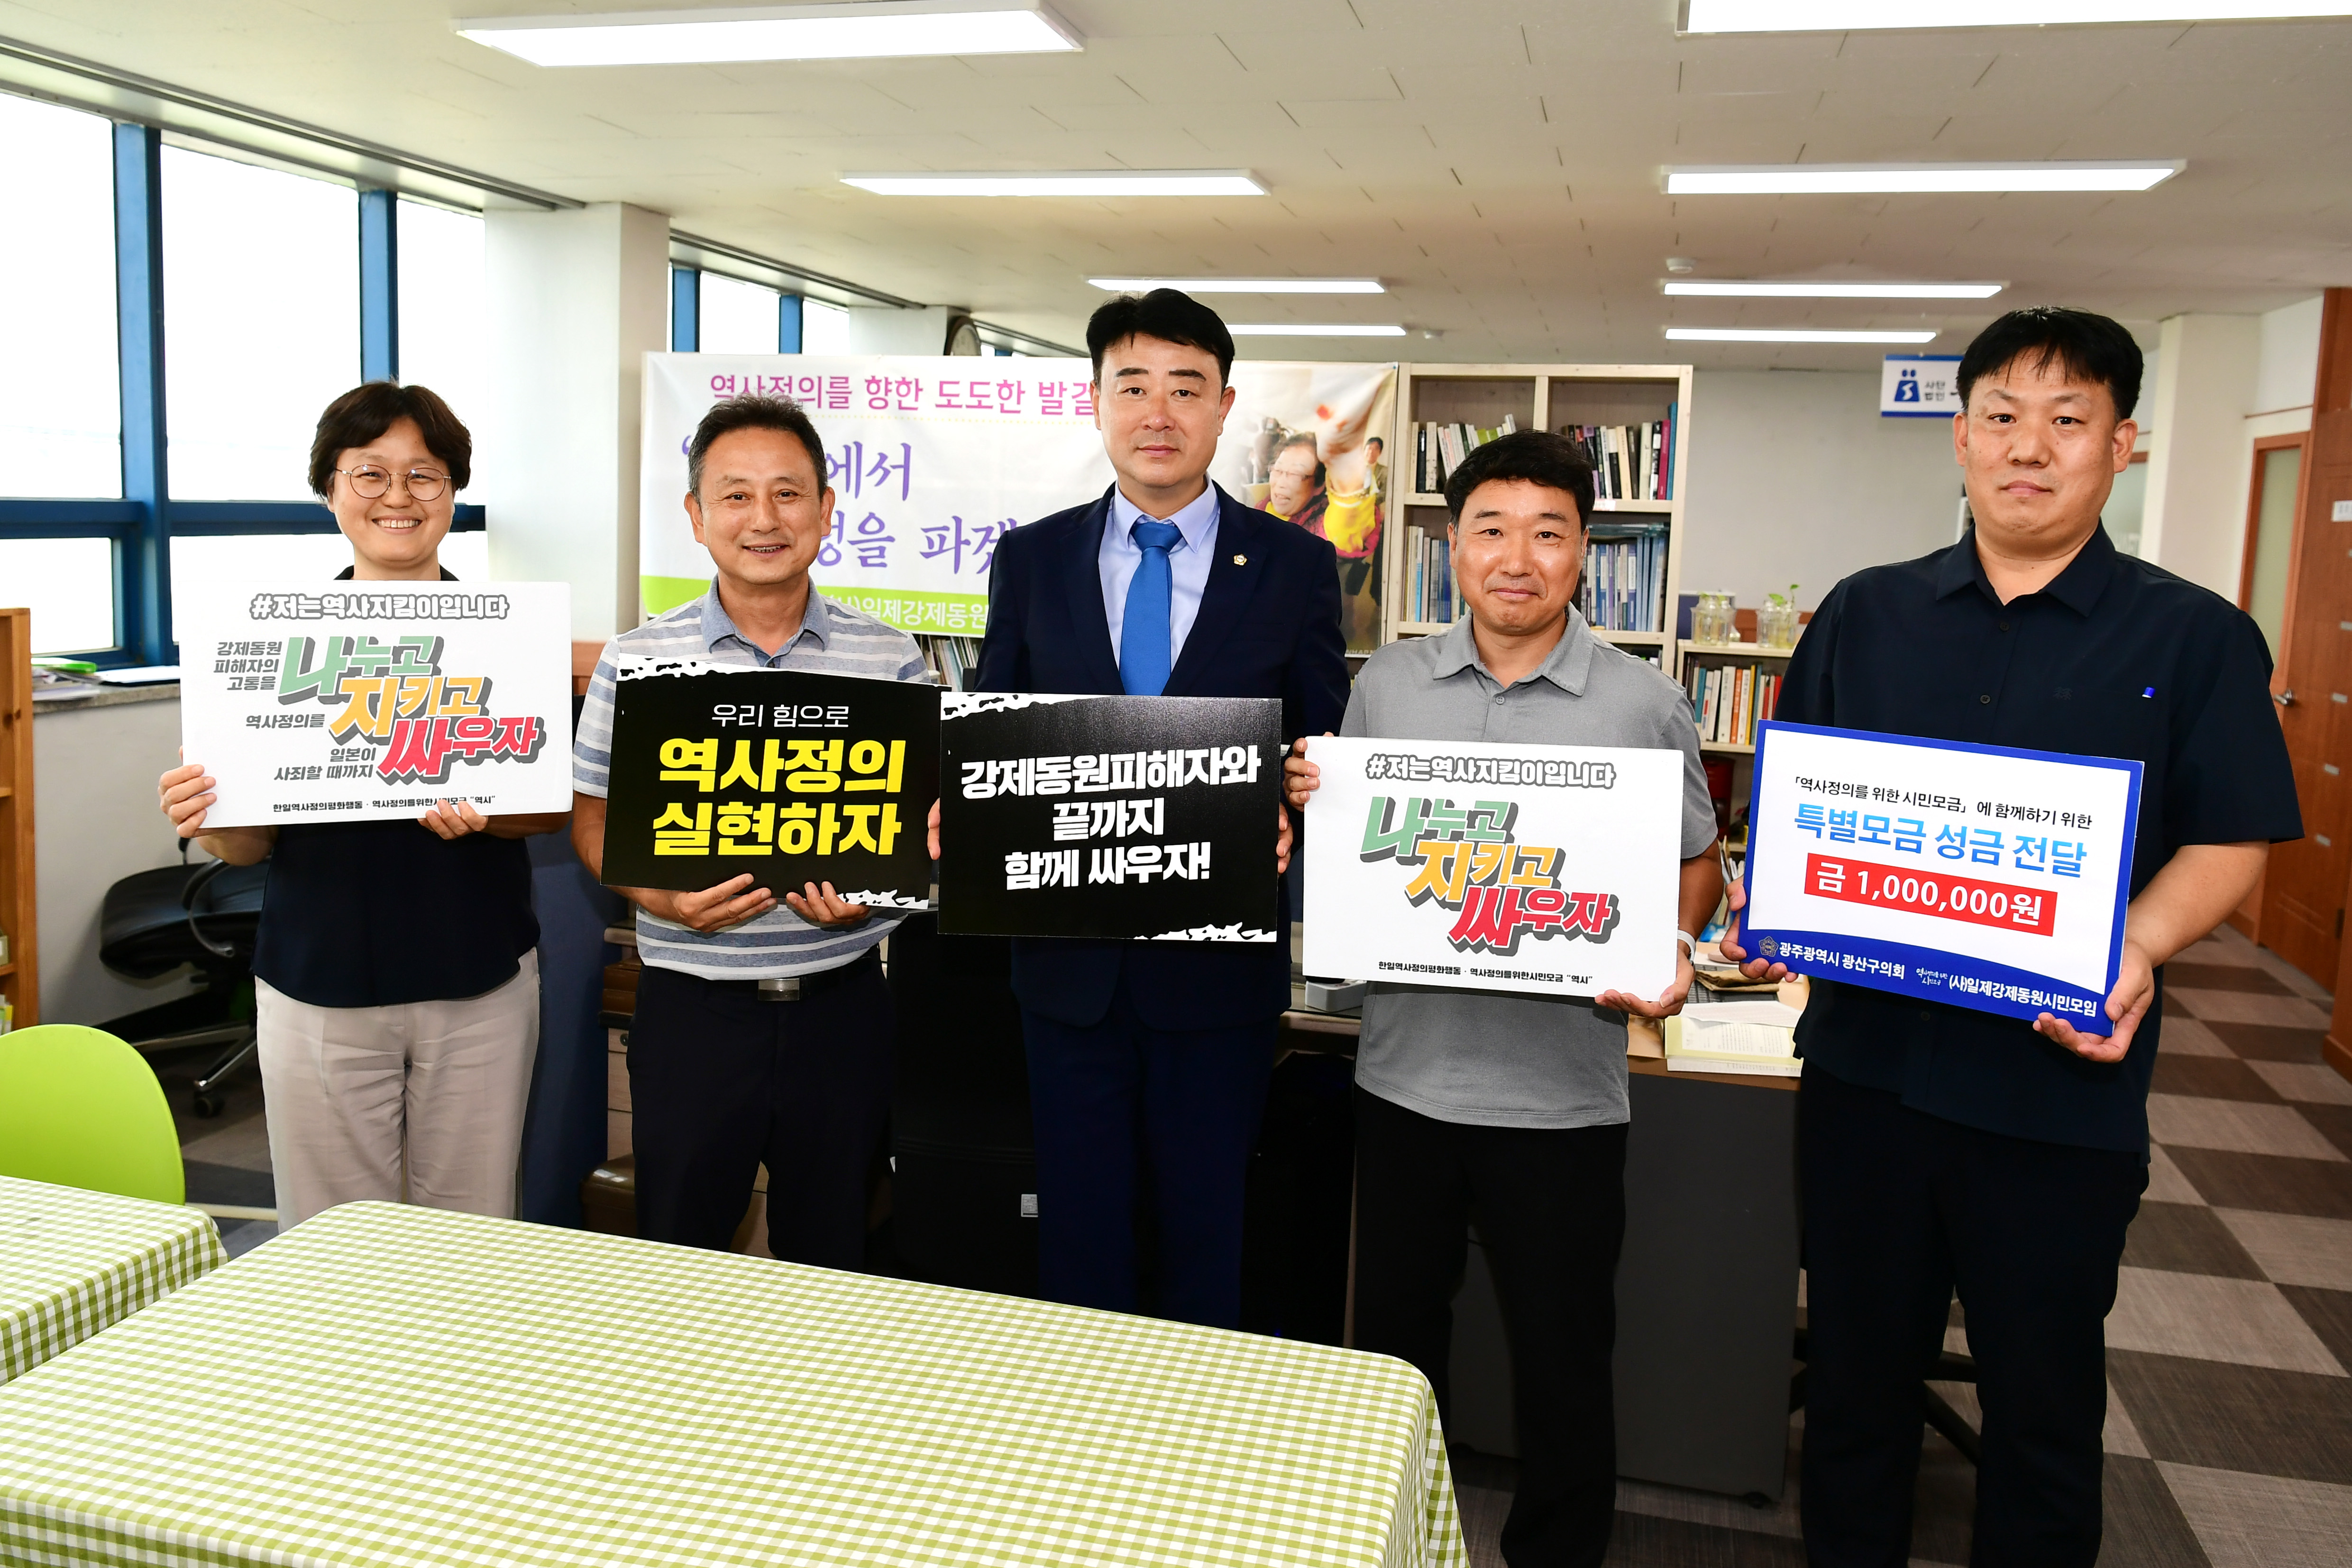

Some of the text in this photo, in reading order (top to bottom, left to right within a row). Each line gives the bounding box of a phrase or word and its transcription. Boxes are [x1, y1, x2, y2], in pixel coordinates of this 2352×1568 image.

[711, 375, 852, 409] 역사정의를
[865, 375, 924, 411] 향한
[935, 379, 1026, 414] 도도한
[250, 594, 509, 620] #저는역사지킴이입니다
[213, 659, 279, 674] 피해자의
[216, 641, 282, 657] 강제동원
[278, 636, 440, 699] 나누고
[227, 676, 276, 691] 고통을
[246, 714, 325, 730] 역사정의를
[329, 677, 487, 740] 지키고
[712, 704, 849, 728] 우리 힘으로
[330, 748, 376, 763] 일본이
[377, 716, 543, 780] 싸우자
[659, 738, 906, 793] 역사정의
[274, 764, 374, 782] 사죄할 때까지
[961, 745, 1262, 799] 강제동원피해자와
[1365, 754, 1616, 789] #저는역사지킴이입니다
[273, 800, 363, 813] 한일역사정의평화행동
[1052, 798, 1164, 841] 끝까지
[1360, 796, 1514, 859] 나누고
[1872, 788, 1900, 803] 위한
[1977, 801, 1992, 816] 에
[1995, 803, 2057, 825] 함께하기
[2060, 812, 2093, 830] 위한
[653, 802, 902, 856] 실현하자
[1794, 803, 2087, 878] 특별모금 성금 전달
[1005, 842, 1211, 890] 함께 싸우자!
[1405, 840, 1562, 905] 지키고
[1817, 862, 2042, 926] 금 1,000,000원
[1447, 886, 1615, 951] 싸우자
[1378, 961, 1462, 976] 한일역사정의평화행동
[1470, 968, 1564, 983] 역사정의를위한시민모금
[1779, 942, 1905, 980] 광주광역시 광산구의회
[1949, 974, 2097, 1018] (사)일제강제동원시민모임
